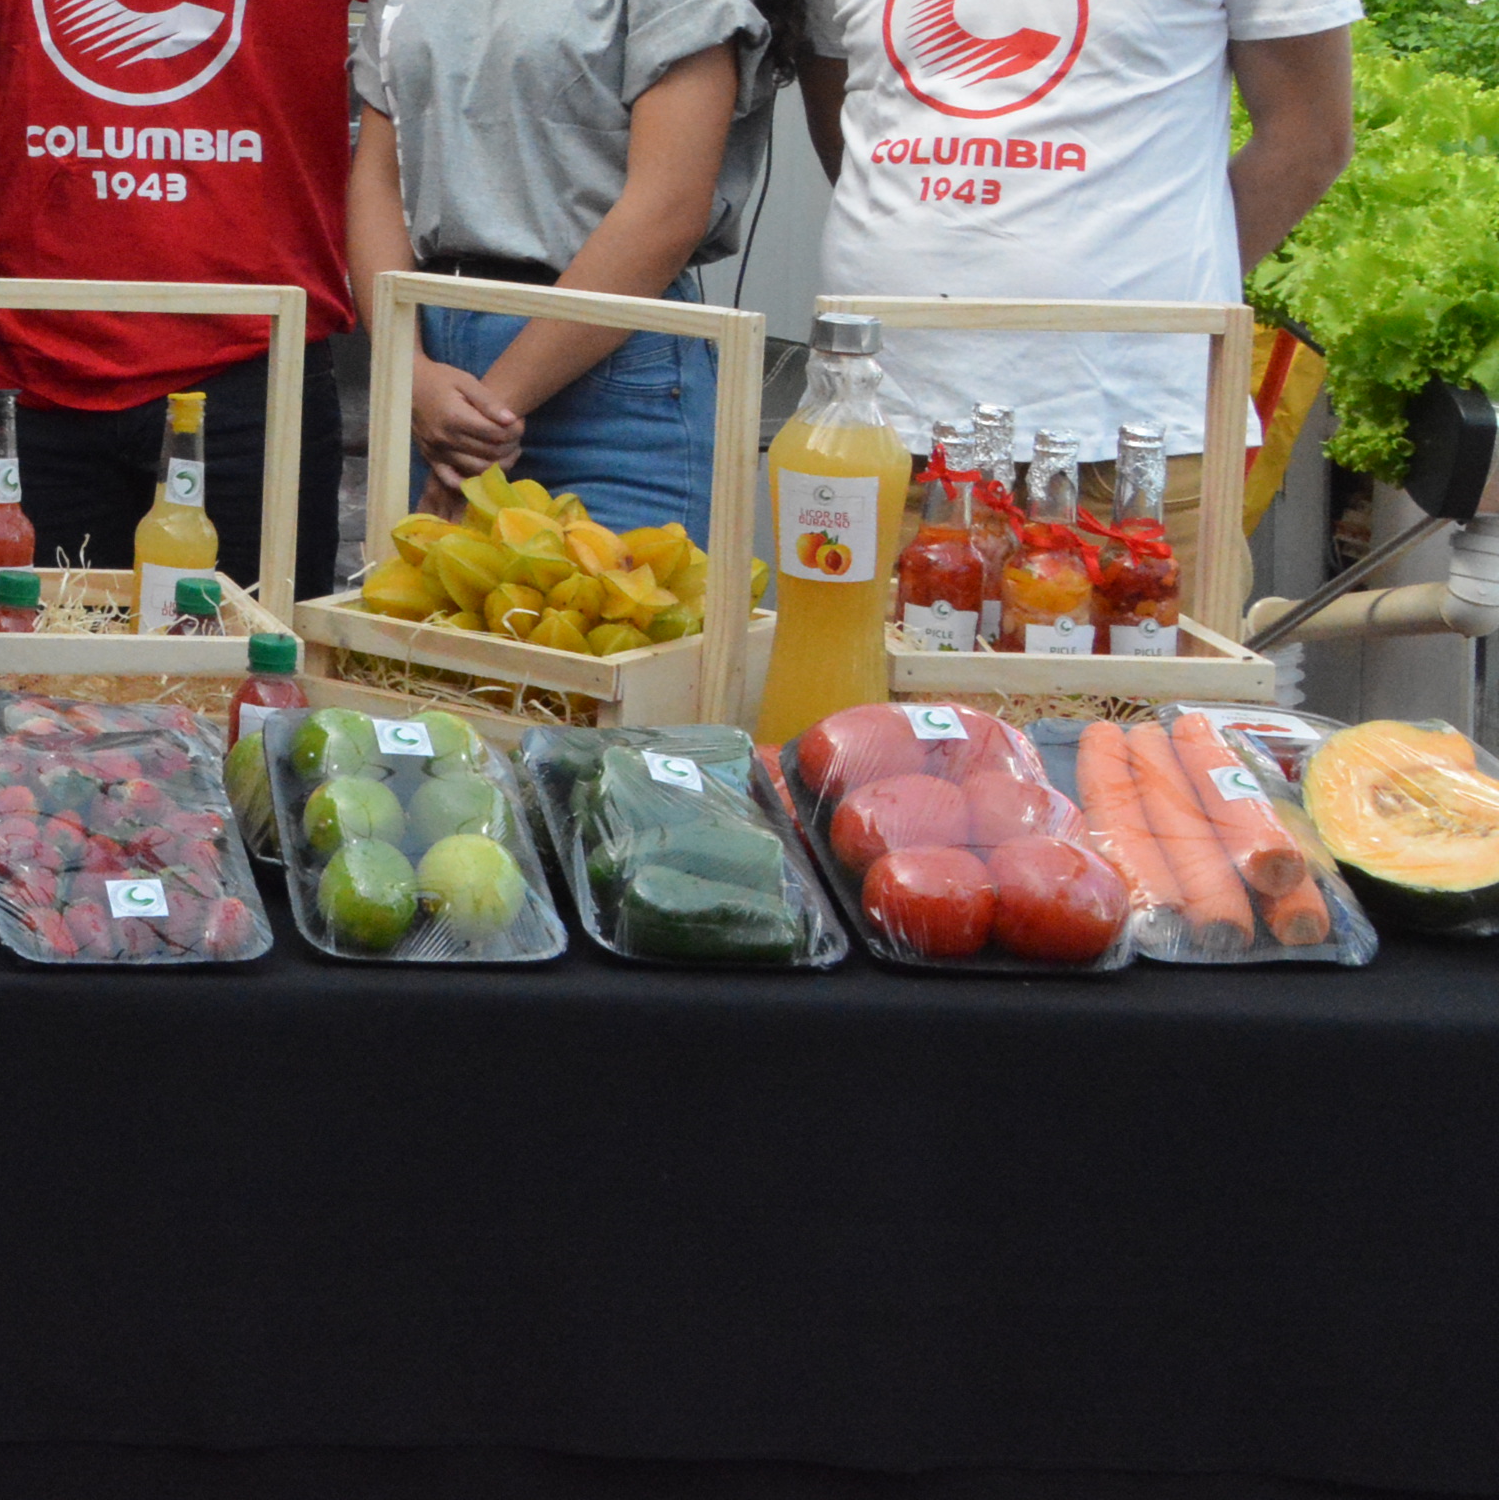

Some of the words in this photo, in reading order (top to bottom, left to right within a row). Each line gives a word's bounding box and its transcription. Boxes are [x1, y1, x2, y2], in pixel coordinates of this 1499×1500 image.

[26, 125, 263, 162] COLUMBIA
[870, 136, 1087, 172] COLUMBIA
[91, 170, 188, 202] 1943
[919, 176, 1003, 206] 1943
[800, 507, 830, 519] LICOR
[834, 511, 849, 520] DE
[925, 627, 954, 640] PICLE
